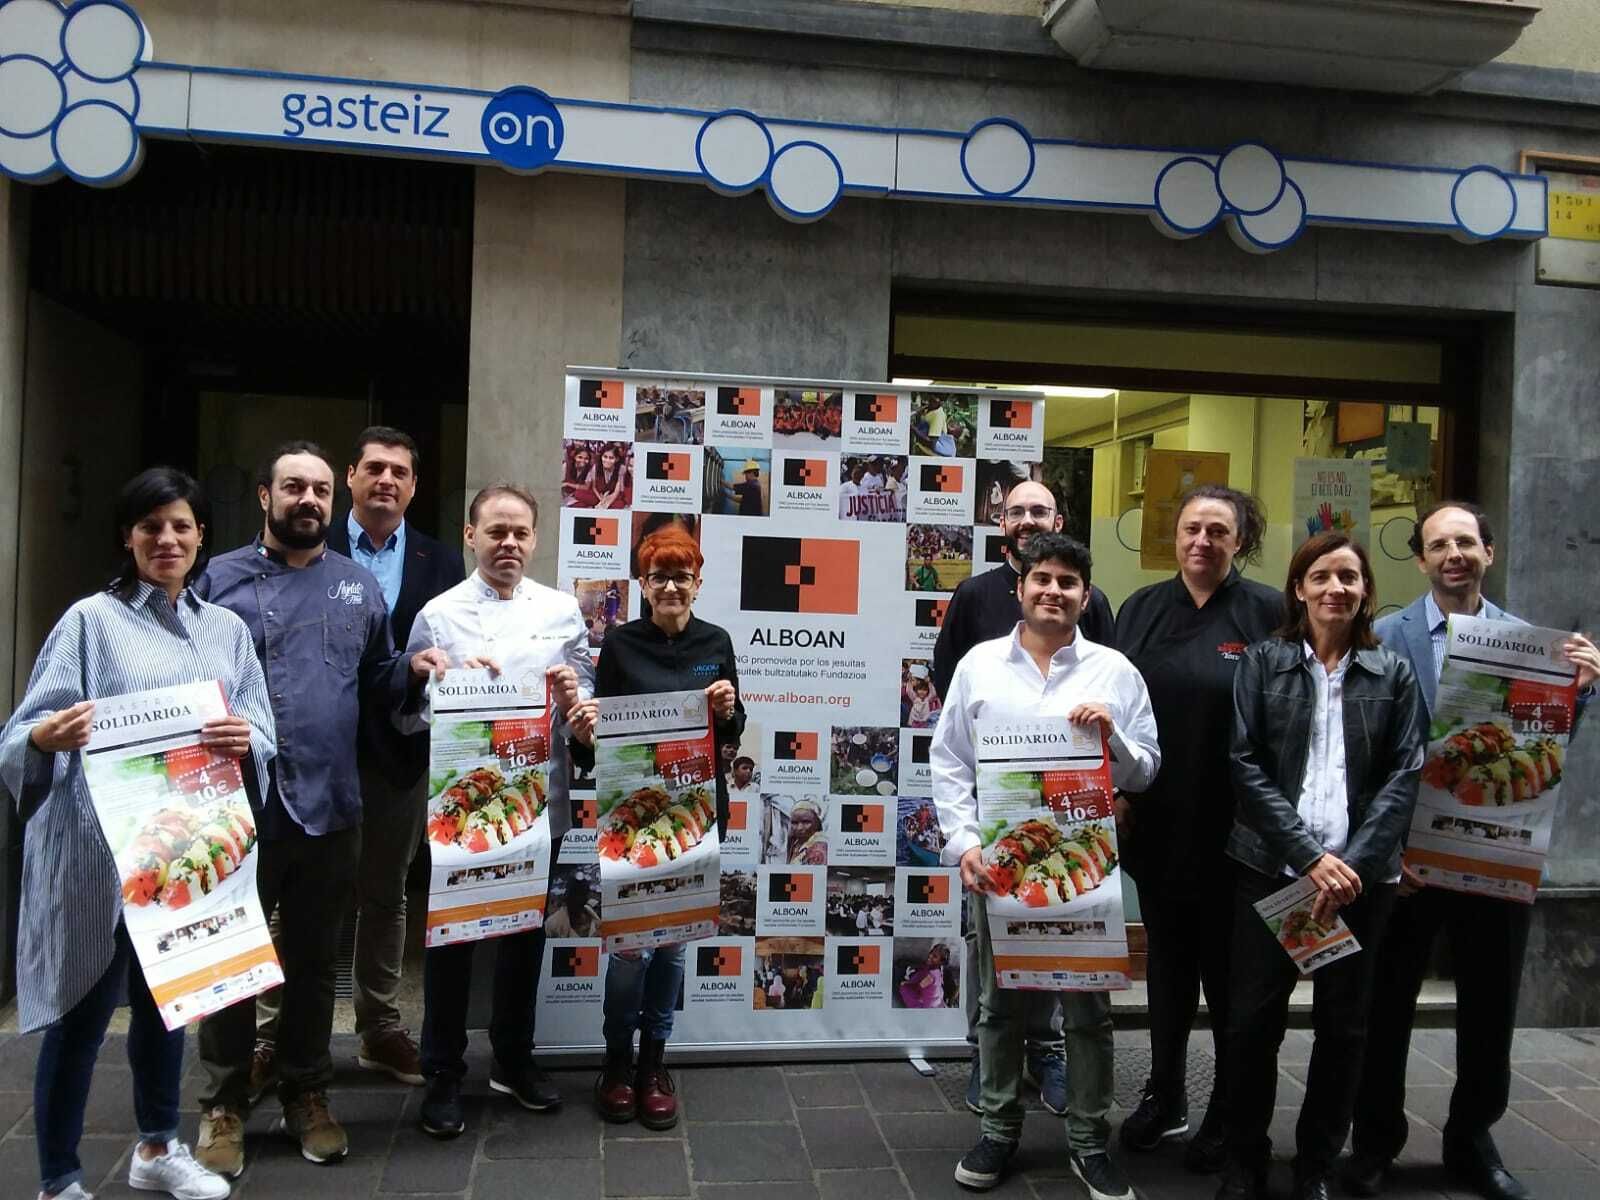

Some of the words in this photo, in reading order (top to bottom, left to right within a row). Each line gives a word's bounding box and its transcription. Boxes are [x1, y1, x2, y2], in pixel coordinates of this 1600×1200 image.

[281, 93, 450, 138] gasteiz
[488, 111, 555, 150] on
[582, 413, 619, 423] ALBOAN
[720, 419, 756, 429] ALBOAN
[857, 427, 893, 436] ALBOAN
[992, 433, 1028, 442] ALBOAN
[649, 484, 686, 494] ALBOAN
[786, 490, 822, 500] ALBOAN
[923, 497, 959, 506] ALBOAN
[576, 550, 613, 560] ALBOAN
[750, 628, 845, 649] ALBOAN
[1457, 633, 1545, 656] SOLIDARIOA
[751, 657, 797, 667] promovida
[800, 658, 815, 668] por
[817, 658, 829, 667] los
[832, 659, 866, 669] jesuitas
[764, 668, 818, 679] bultzatutako
[820, 670, 867, 680] Fundazioa
[438, 684, 518, 697] SOLIDARIOA
[741, 691, 851, 707] www.alboan.org
[601, 707, 679, 724] SOLIDARIOA
[1531, 706, 1542, 718] 4
[91, 704, 192, 733] SOLIDARIOA
[982, 733, 1068, 746] SOLIDARIOA
[506, 743, 516, 755] 4
[671, 764, 680, 775] 4
[777, 765, 813, 774] ALBOAN
[199, 771, 210, 785] 4
[1060, 796, 1072, 808] 4
[844, 838, 880, 847] ALBOAN
[772, 907, 808, 917] ALBOAN
[910, 908, 945, 917] ALBOAN
[555, 983, 593, 992] ALBOAN
[700, 982, 736, 991] ALBOAN
[840, 980, 876, 989] ALBOAN
